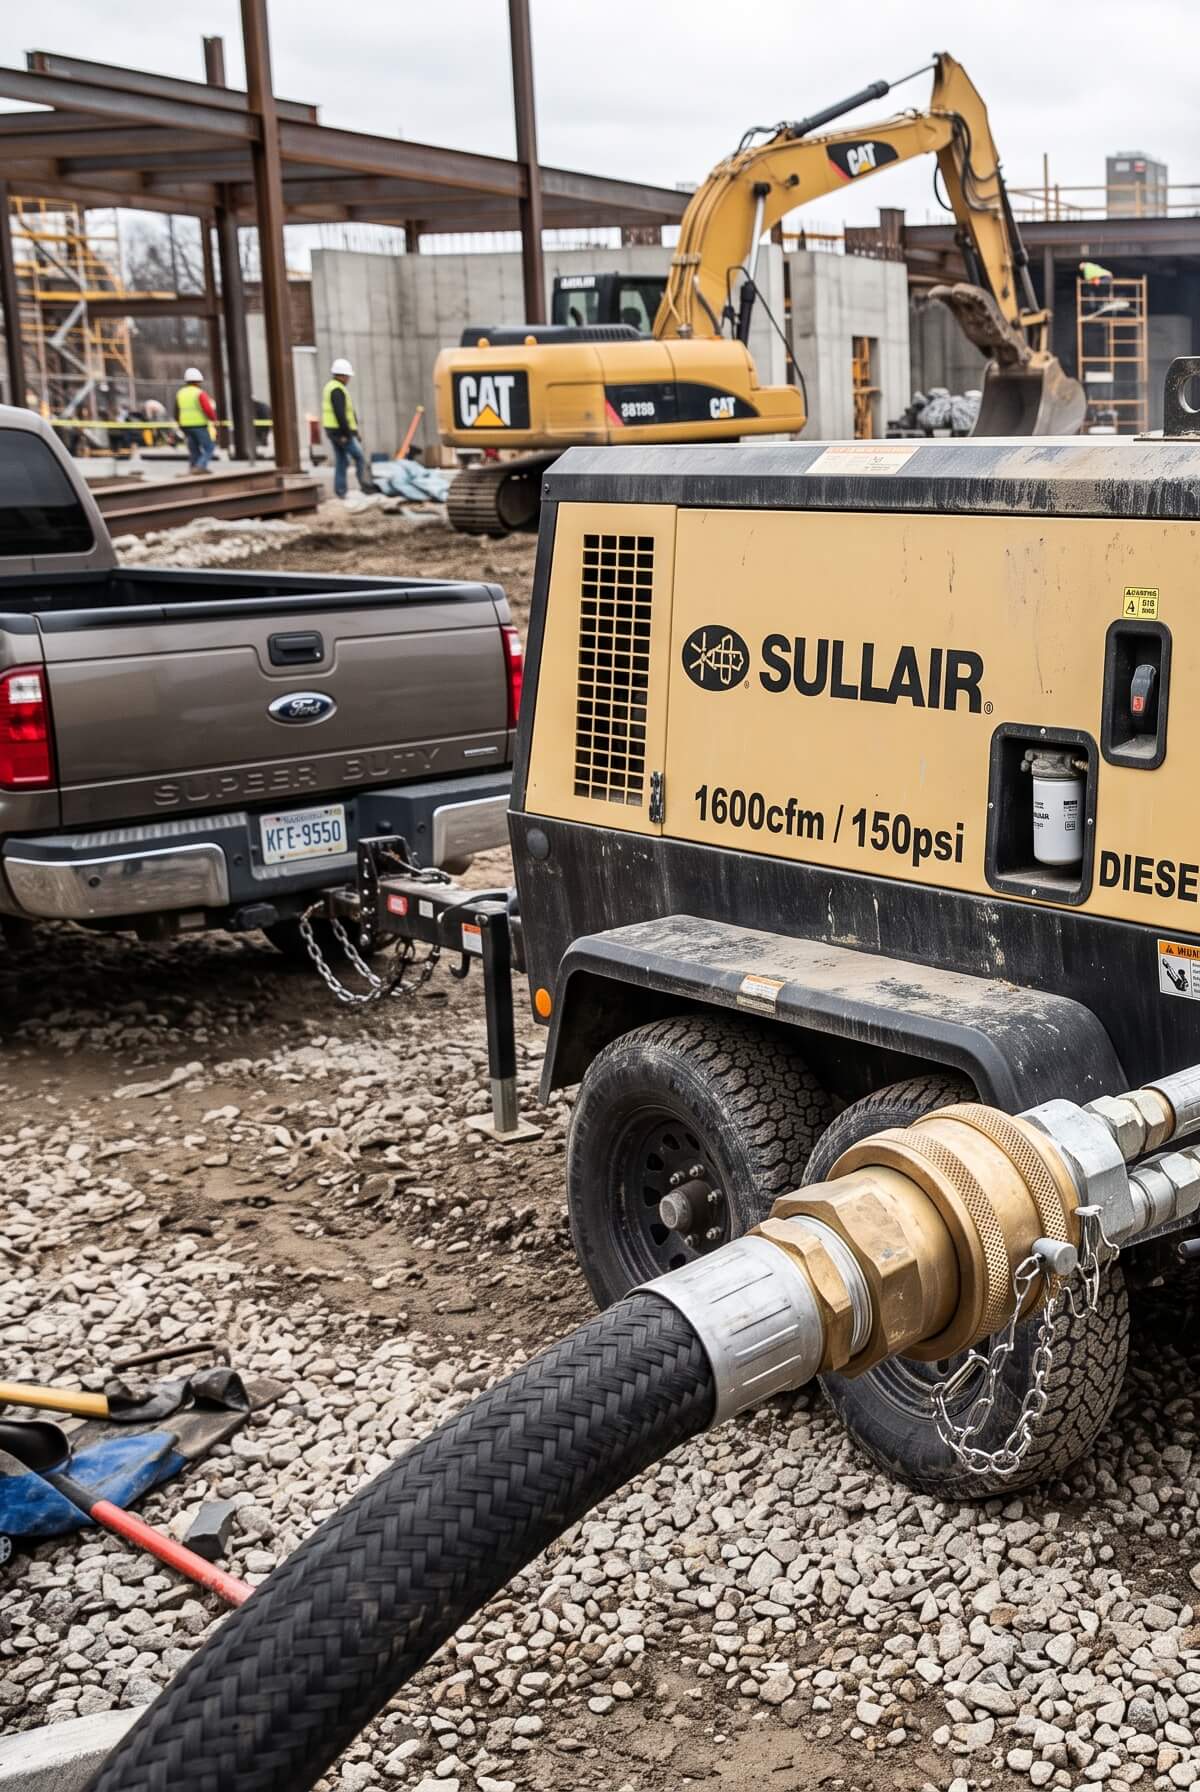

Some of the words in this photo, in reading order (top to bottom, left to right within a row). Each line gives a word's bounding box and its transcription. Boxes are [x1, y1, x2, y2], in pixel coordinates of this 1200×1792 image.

[846, 142, 877, 176] CAT
[458, 375, 515, 427] CAT
[709, 396, 736, 419] CAT
[759, 633, 985, 714] SULLAIR
[289, 698, 321, 717] Ford
[266, 819, 341, 852] KFE-9550
[695, 784, 824, 841] 1600cfm
[832, 804, 844, 843] /
[852, 808, 964, 867] 150psi
